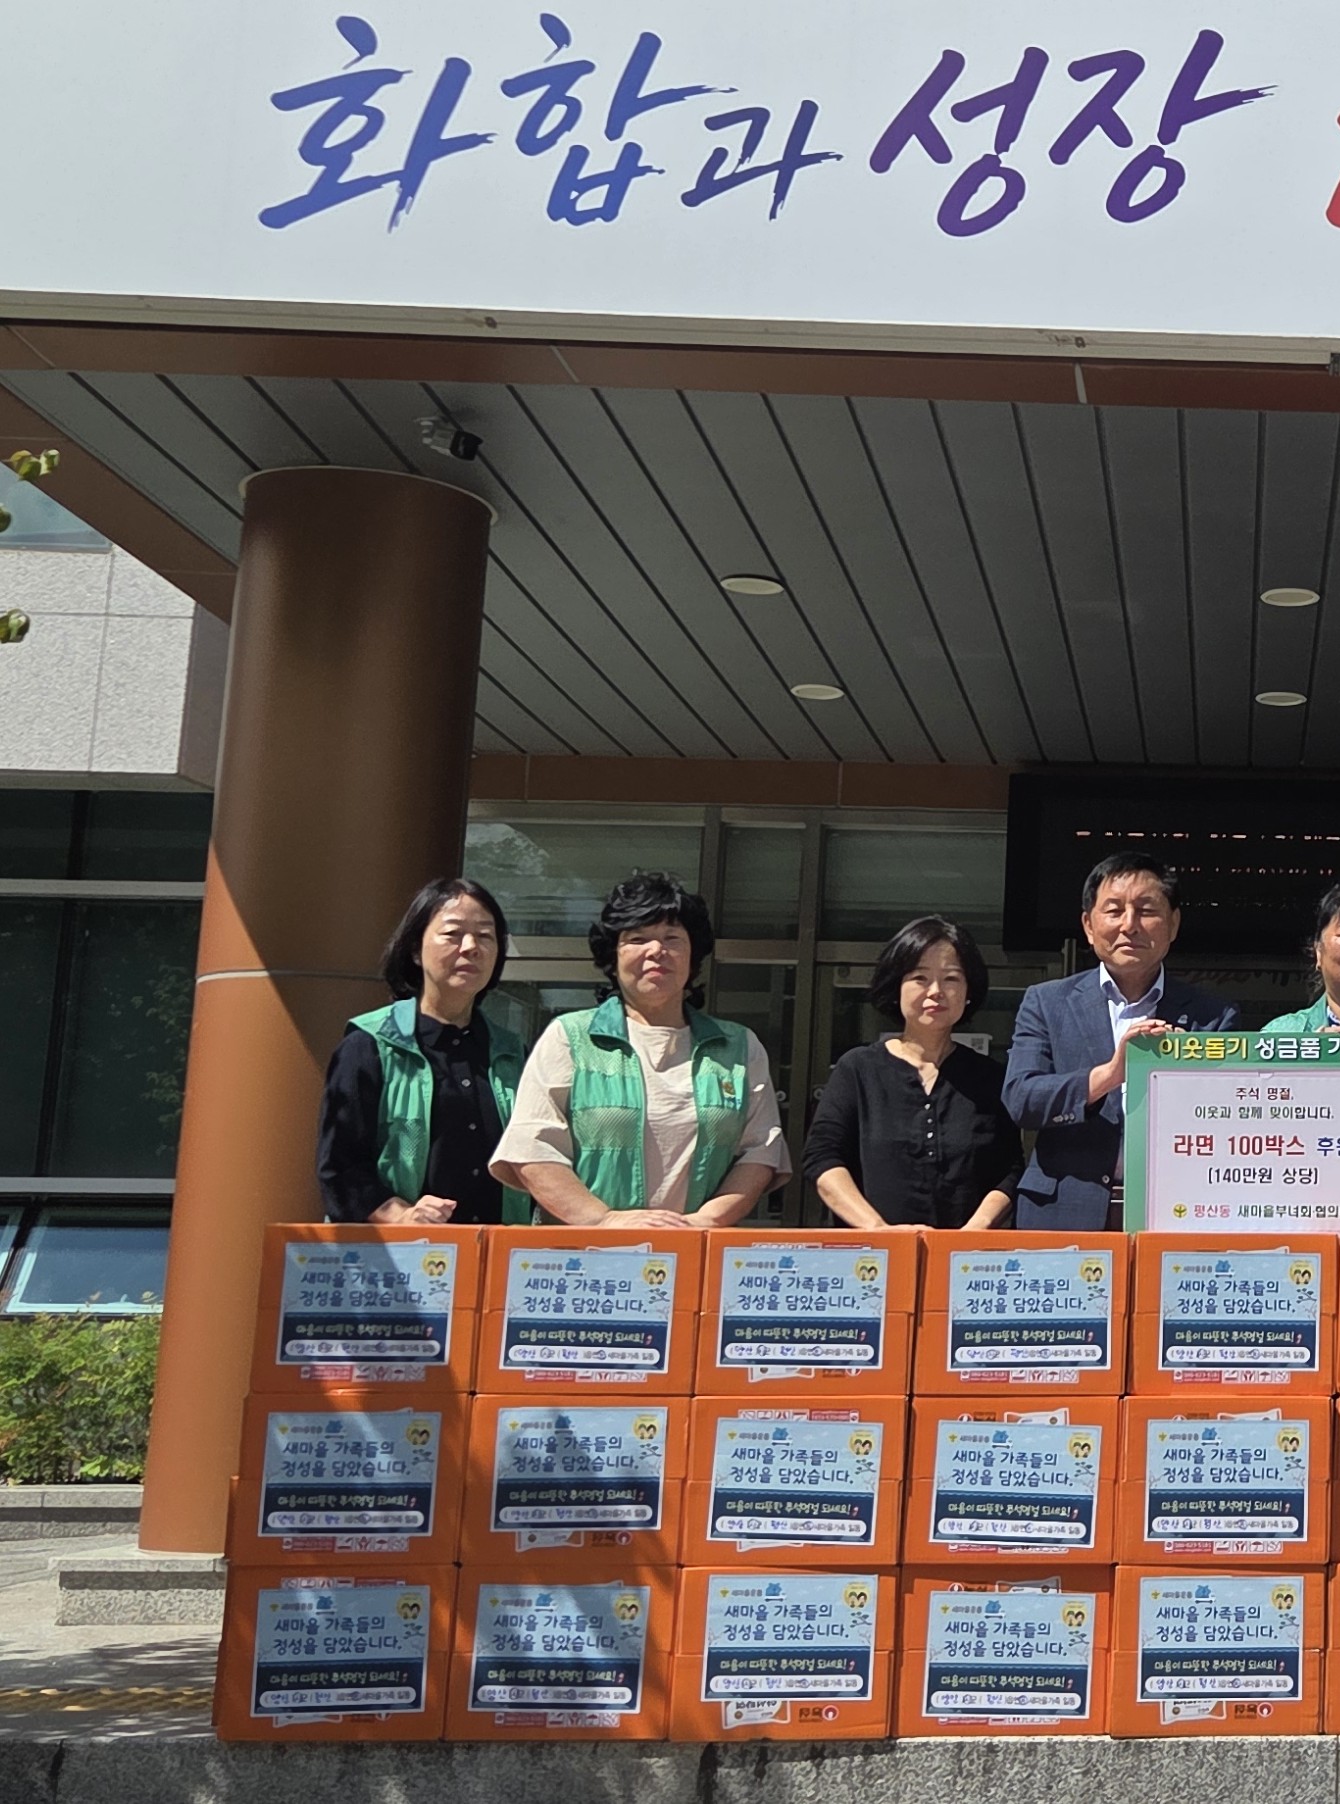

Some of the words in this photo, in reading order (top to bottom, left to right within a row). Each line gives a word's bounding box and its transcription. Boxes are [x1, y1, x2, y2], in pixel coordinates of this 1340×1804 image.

[258, 14, 842, 230] 화합과
[869, 30, 1275, 237] 성장
[1160, 1037, 1248, 1060] 이웃돕기
[1254, 1037, 1322, 1060] 성금품
[1194, 1105, 1232, 1120] 이웃과
[1238, 1105, 1263, 1120] 함께
[1269, 1105, 1335, 1120] 맞이합니다.
[1174, 1134, 1214, 1157] 라면
[1228, 1134, 1305, 1157] 100박스
[1194, 1204, 1230, 1218] 평산동
[523, 1277, 569, 1295] 새마을
[572, 1279, 632, 1296] 가족들의
[737, 1276, 783, 1292] 새마을
[786, 1277, 844, 1293] 가족들의
[966, 1279, 1009, 1296] 새마을
[1013, 1278, 1070, 1295] 가족들의
[1176, 1280, 1220, 1296] 새마을
[1223, 1280, 1279, 1296] 가족들의
[522, 1296, 567, 1313] 정성을
[570, 1297, 649, 1314] 담았습니다.
[737, 1294, 781, 1310] 정성을
[784, 1295, 862, 1311] 담았습니다.
[966, 1297, 1008, 1314] 정성을
[1012, 1296, 1088, 1313] 담았습니다.
[1177, 1298, 1218, 1314] 정성을
[1222, 1298, 1297, 1314] 담았습니다.
[282, 1441, 330, 1459] 새마을
[332, 1441, 395, 1458] 가족들의
[730, 1447, 776, 1465] 새마을
[779, 1449, 838, 1466] 가족들의
[1162, 1448, 1206, 1465] 새마을
[1210, 1448, 1267, 1465] 가족들의
[281, 1460, 327, 1477] 정성을
[330, 1459, 413, 1477] 담았습니다.
[951, 1450, 996, 1467] 새마을
[999, 1452, 1058, 1469] 가족들의
[729, 1466, 774, 1483] 정성을
[776, 1467, 856, 1485] 담았습니다.
[951, 1468, 994, 1486] 정성을
[997, 1470, 1075, 1488] 담았습니다.
[1163, 1467, 1205, 1483] 정성을
[1209, 1466, 1285, 1483] 담았습니다.
[723, 1604, 770, 1622] 새마을
[773, 1604, 833, 1622] 가족들의
[1155, 1606, 1200, 1624] 새마을
[1203, 1606, 1261, 1623] 가족들의
[273, 1618, 320, 1637] 새마을
[324, 1616, 385, 1635] 가족들의
[723, 1624, 768, 1641] 정성을
[771, 1622, 851, 1641] 담았습니다.
[944, 1621, 989, 1638] 새마을
[992, 1622, 1051, 1639] 가족들의
[1156, 1625, 1199, 1642] 정성을
[1202, 1624, 1279, 1642] 담았습니다.
[272, 1637, 319, 1656] 정성을
[322, 1634, 404, 1654] 담았습니다.
[943, 1640, 987, 1657] 정성을
[990, 1641, 1069, 1658] 담았습니다.
